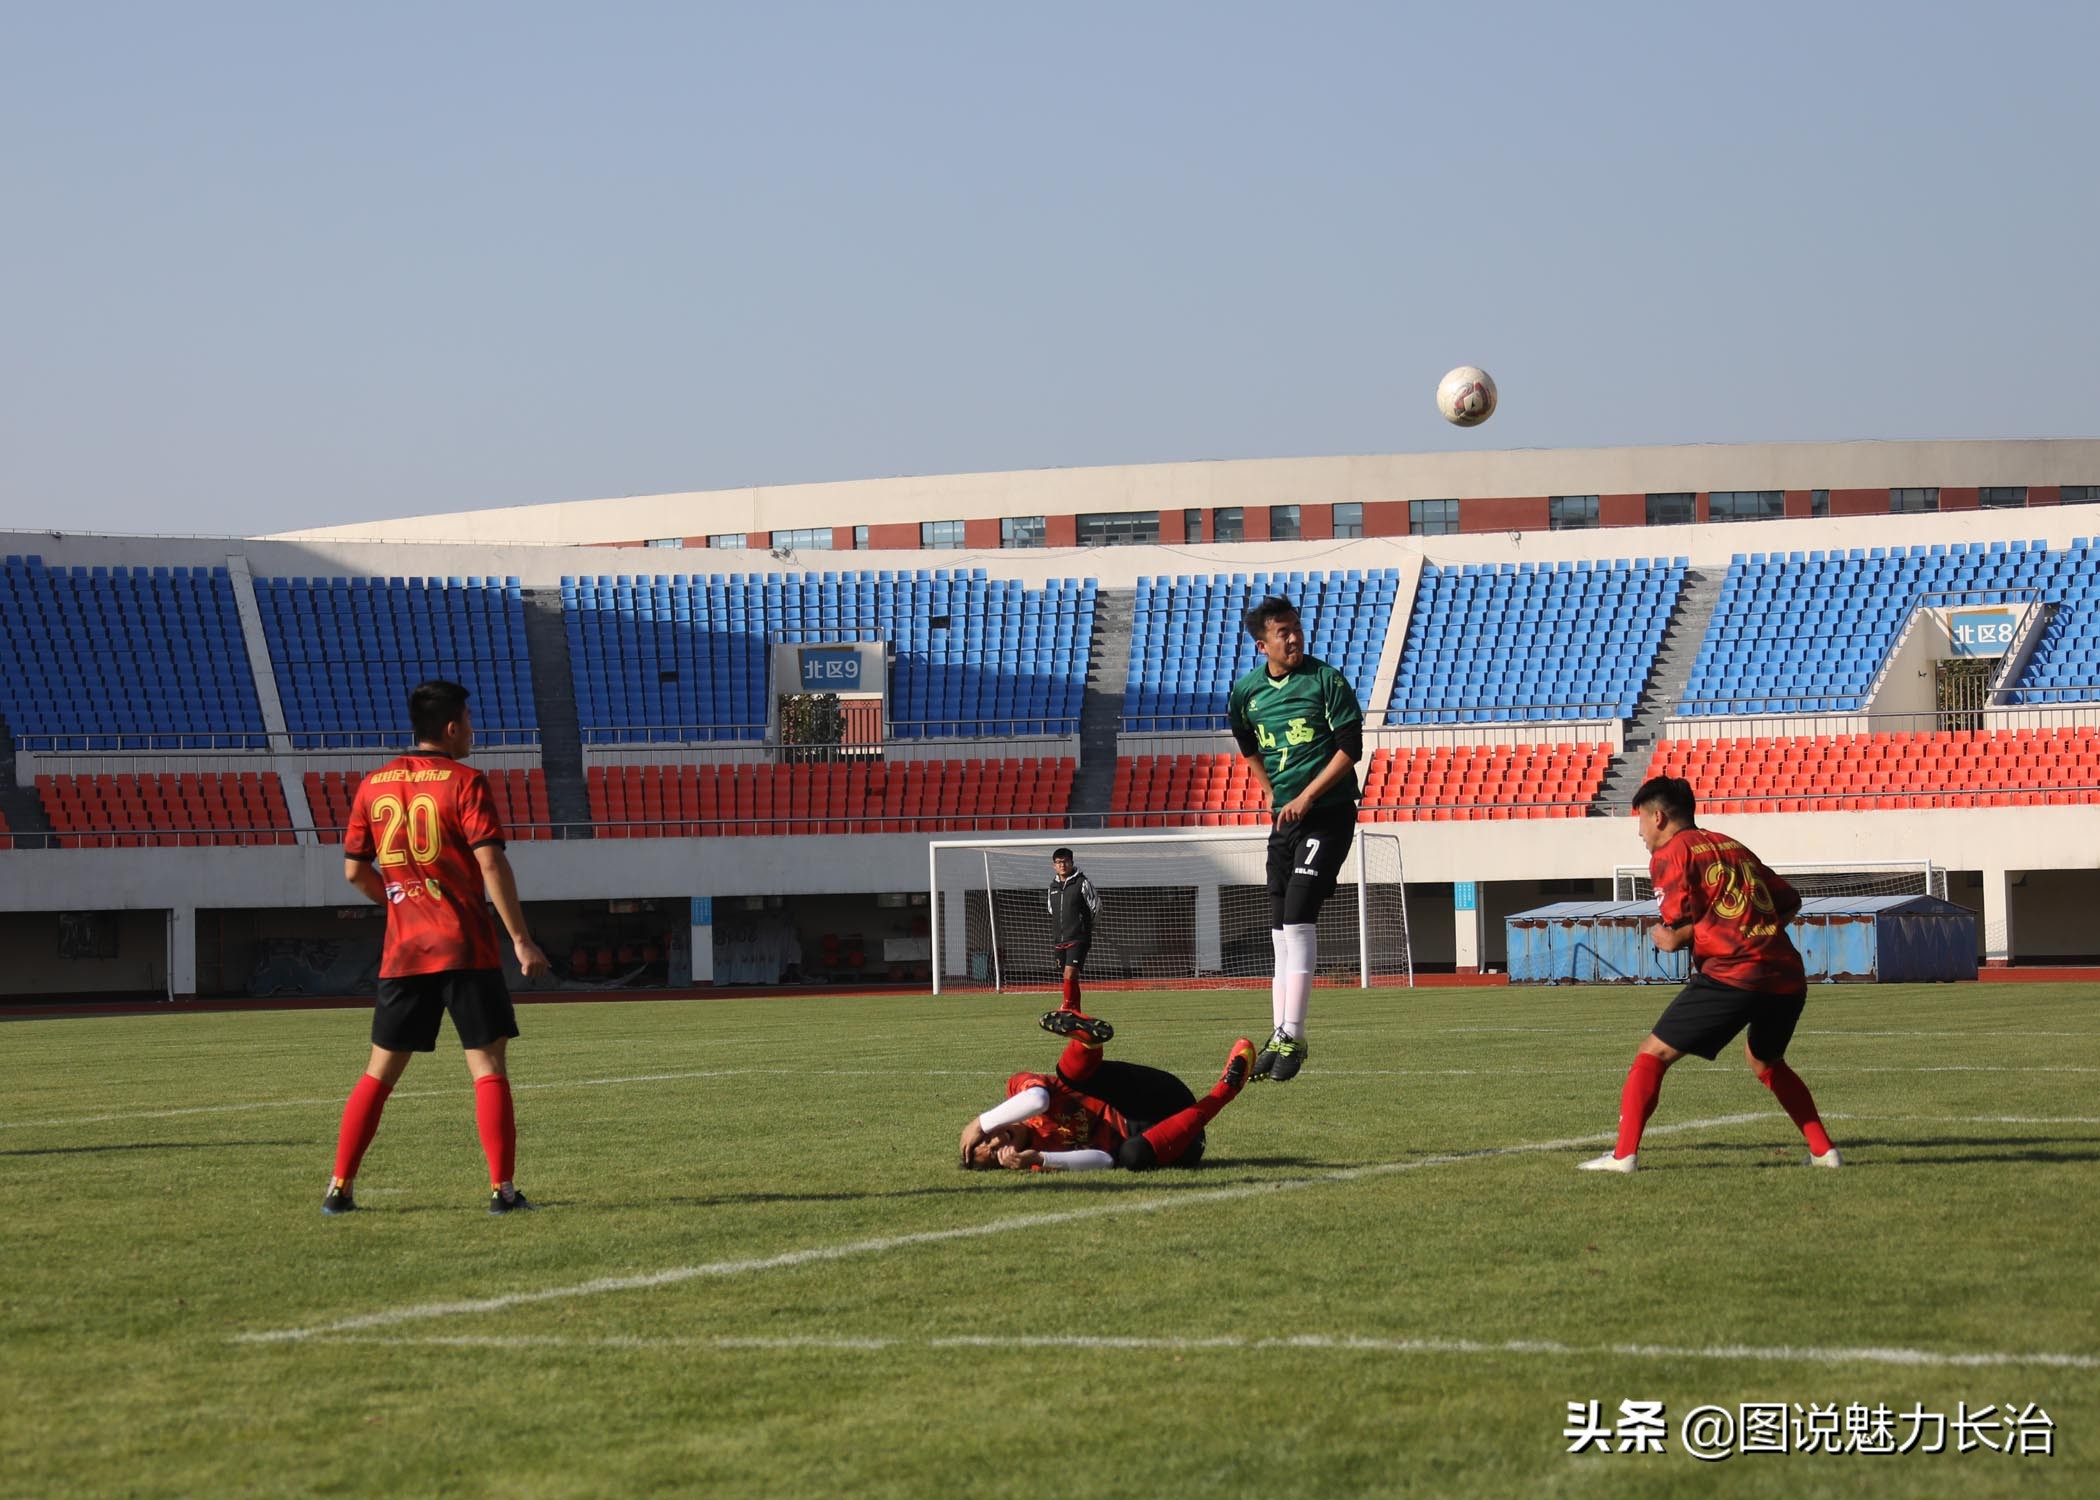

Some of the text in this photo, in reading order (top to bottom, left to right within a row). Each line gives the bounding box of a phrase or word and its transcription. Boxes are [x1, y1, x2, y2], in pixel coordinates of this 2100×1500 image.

[1954, 623, 2012, 644] 北区8
[804, 660, 858, 679] 北区9
[1277, 747, 1288, 772] 7
[371, 793, 441, 868] 20
[1304, 838, 1320, 865] 7
